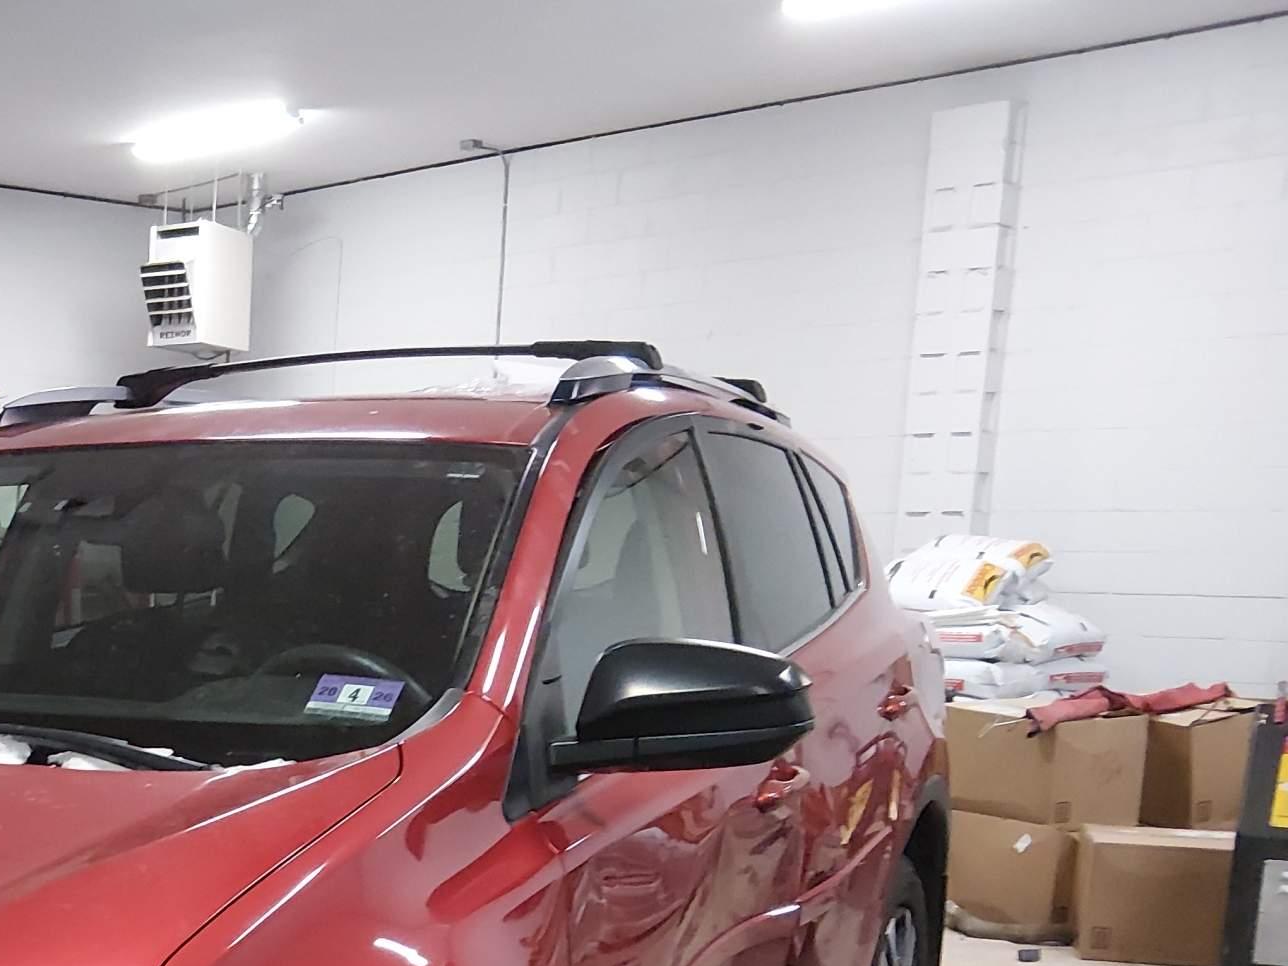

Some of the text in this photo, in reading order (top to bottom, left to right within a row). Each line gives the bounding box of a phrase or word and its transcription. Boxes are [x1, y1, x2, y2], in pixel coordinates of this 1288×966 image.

[317, 686, 394, 702] 20 4 26
